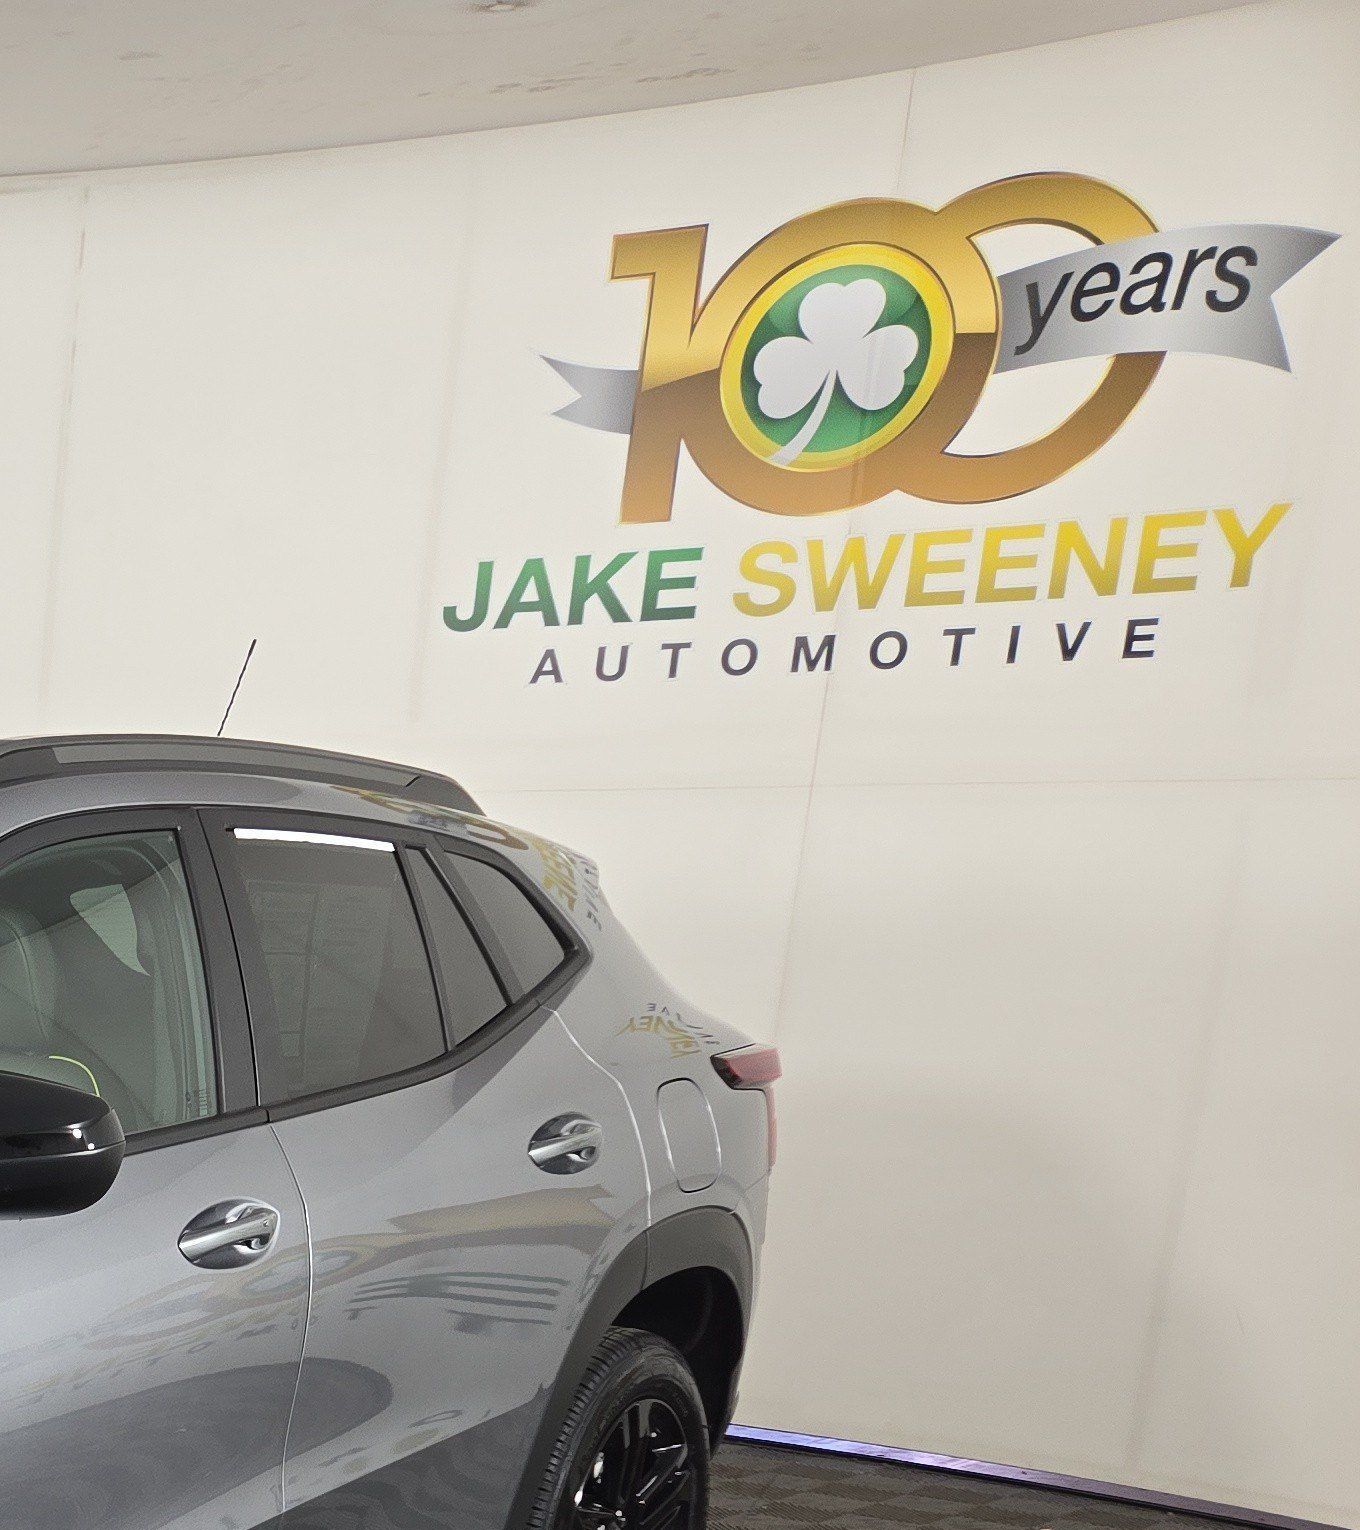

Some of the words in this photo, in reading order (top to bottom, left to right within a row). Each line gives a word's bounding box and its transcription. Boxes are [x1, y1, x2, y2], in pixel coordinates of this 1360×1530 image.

[610, 172, 1170, 525] 100
[1014, 245, 1259, 356] years
[442, 546, 704, 633] JAKE
[732, 502, 1294, 619] SWEENEY
[529, 618, 1162, 685] AUTOMOTIVE
